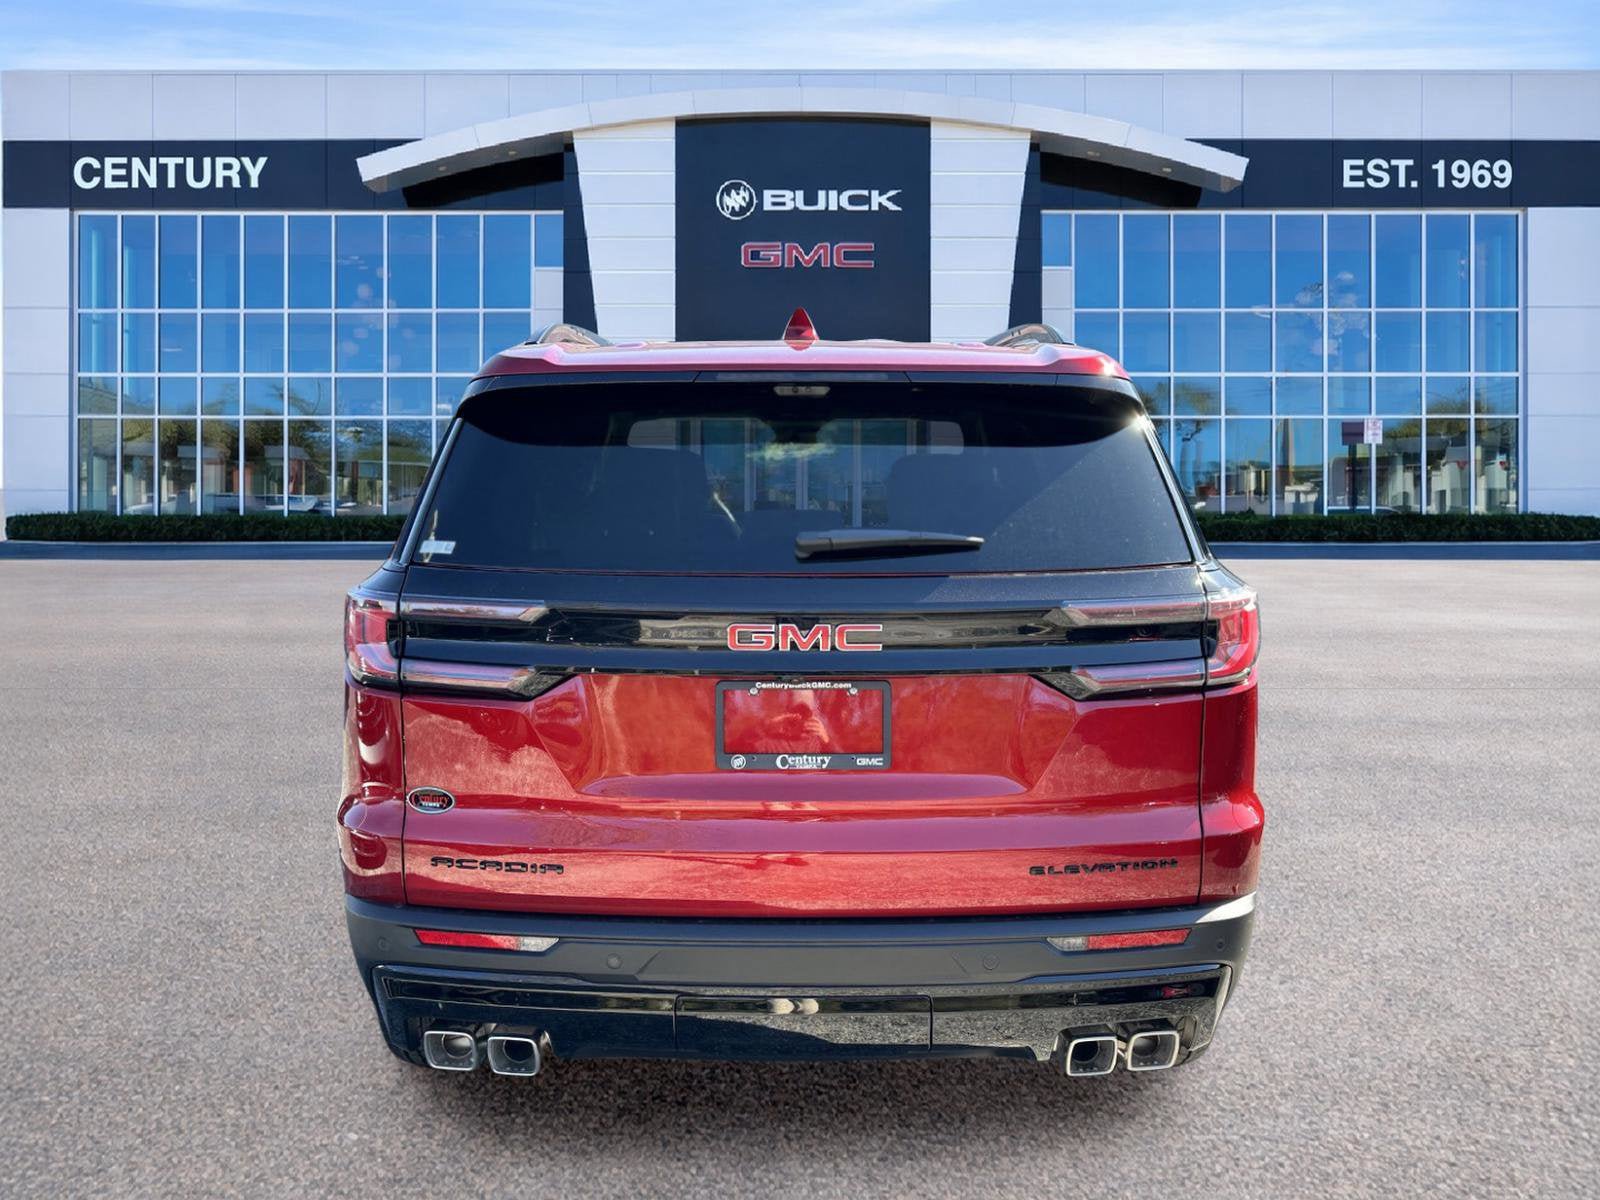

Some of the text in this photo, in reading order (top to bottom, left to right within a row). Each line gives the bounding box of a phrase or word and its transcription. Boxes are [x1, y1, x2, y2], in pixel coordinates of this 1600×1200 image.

[73, 156, 268, 189] CENTURY
[1342, 158, 1513, 188] EST. 1969
[762, 189, 902, 211] BUICK
[741, 242, 875, 268] GMC
[727, 624, 883, 651] GMC
[775, 754, 832, 769] Century
[856, 757, 884, 766] GMC
[430, 856, 564, 874] ACADIA
[1029, 858, 1179, 875] ELEVATION
